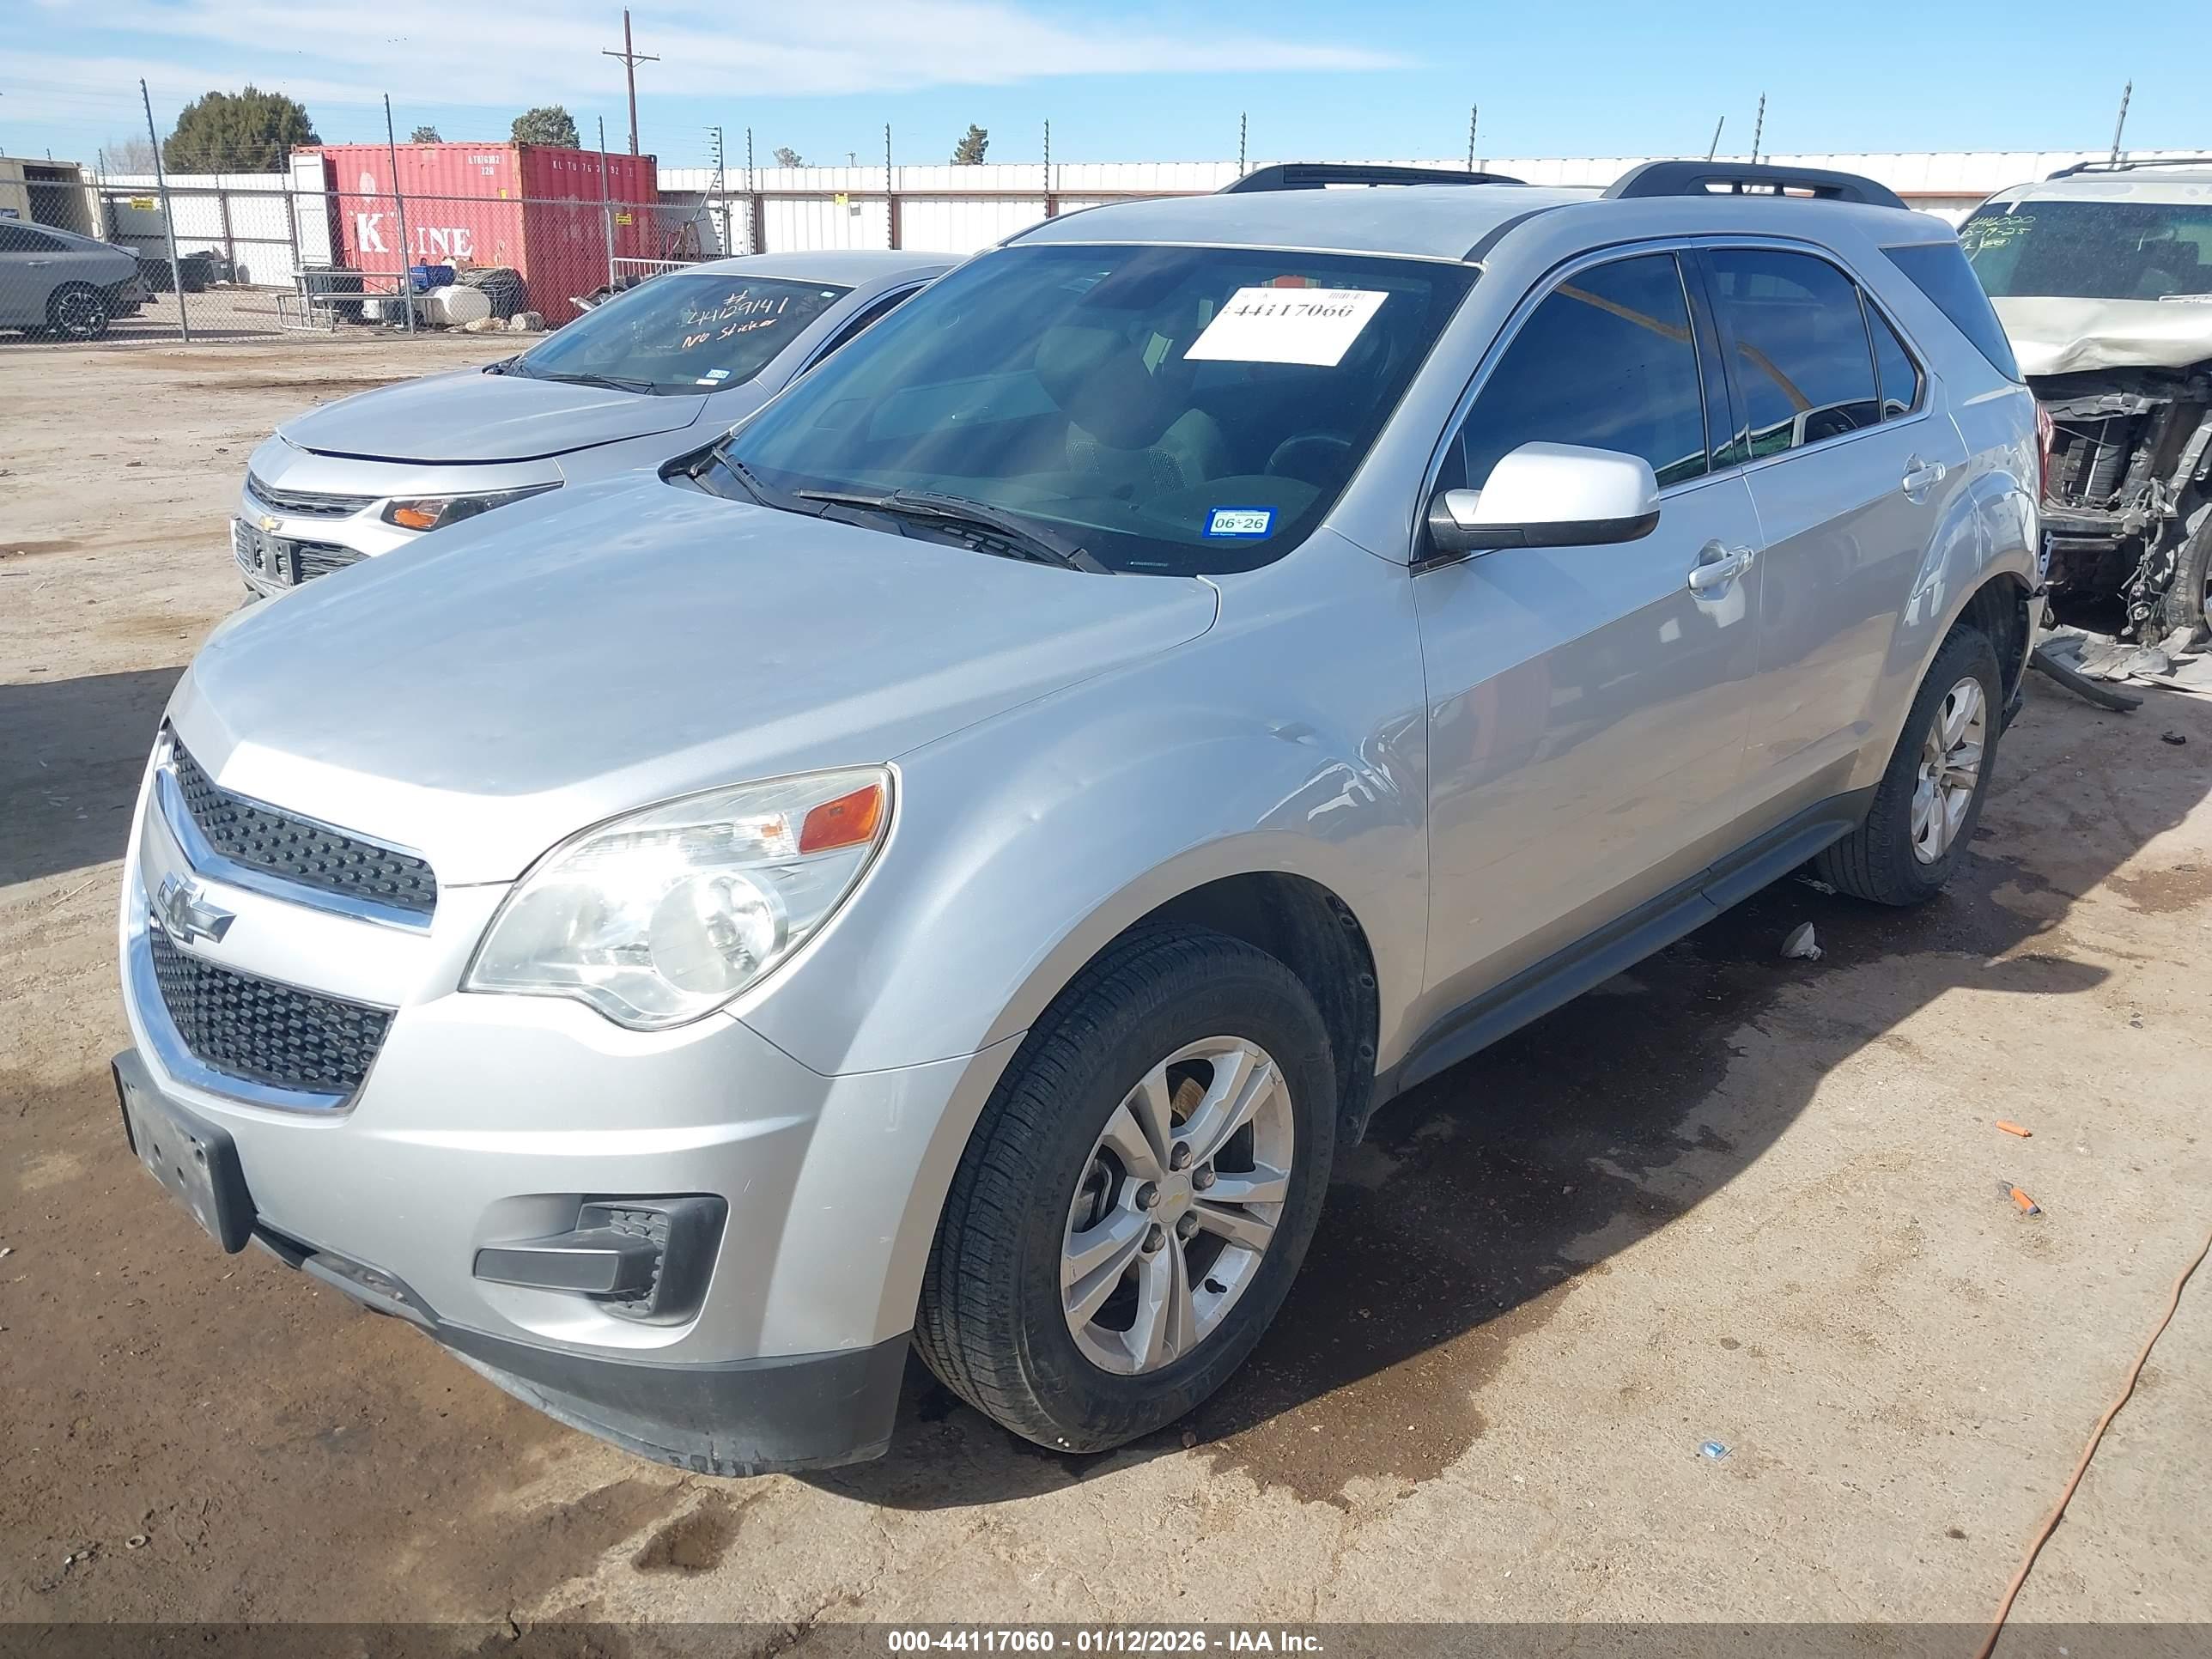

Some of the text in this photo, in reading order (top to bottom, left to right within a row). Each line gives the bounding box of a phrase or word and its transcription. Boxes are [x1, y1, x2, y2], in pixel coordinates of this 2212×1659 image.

[1234, 303, 1354, 317] 44117060
[1215, 518, 1265, 529] 06 26
